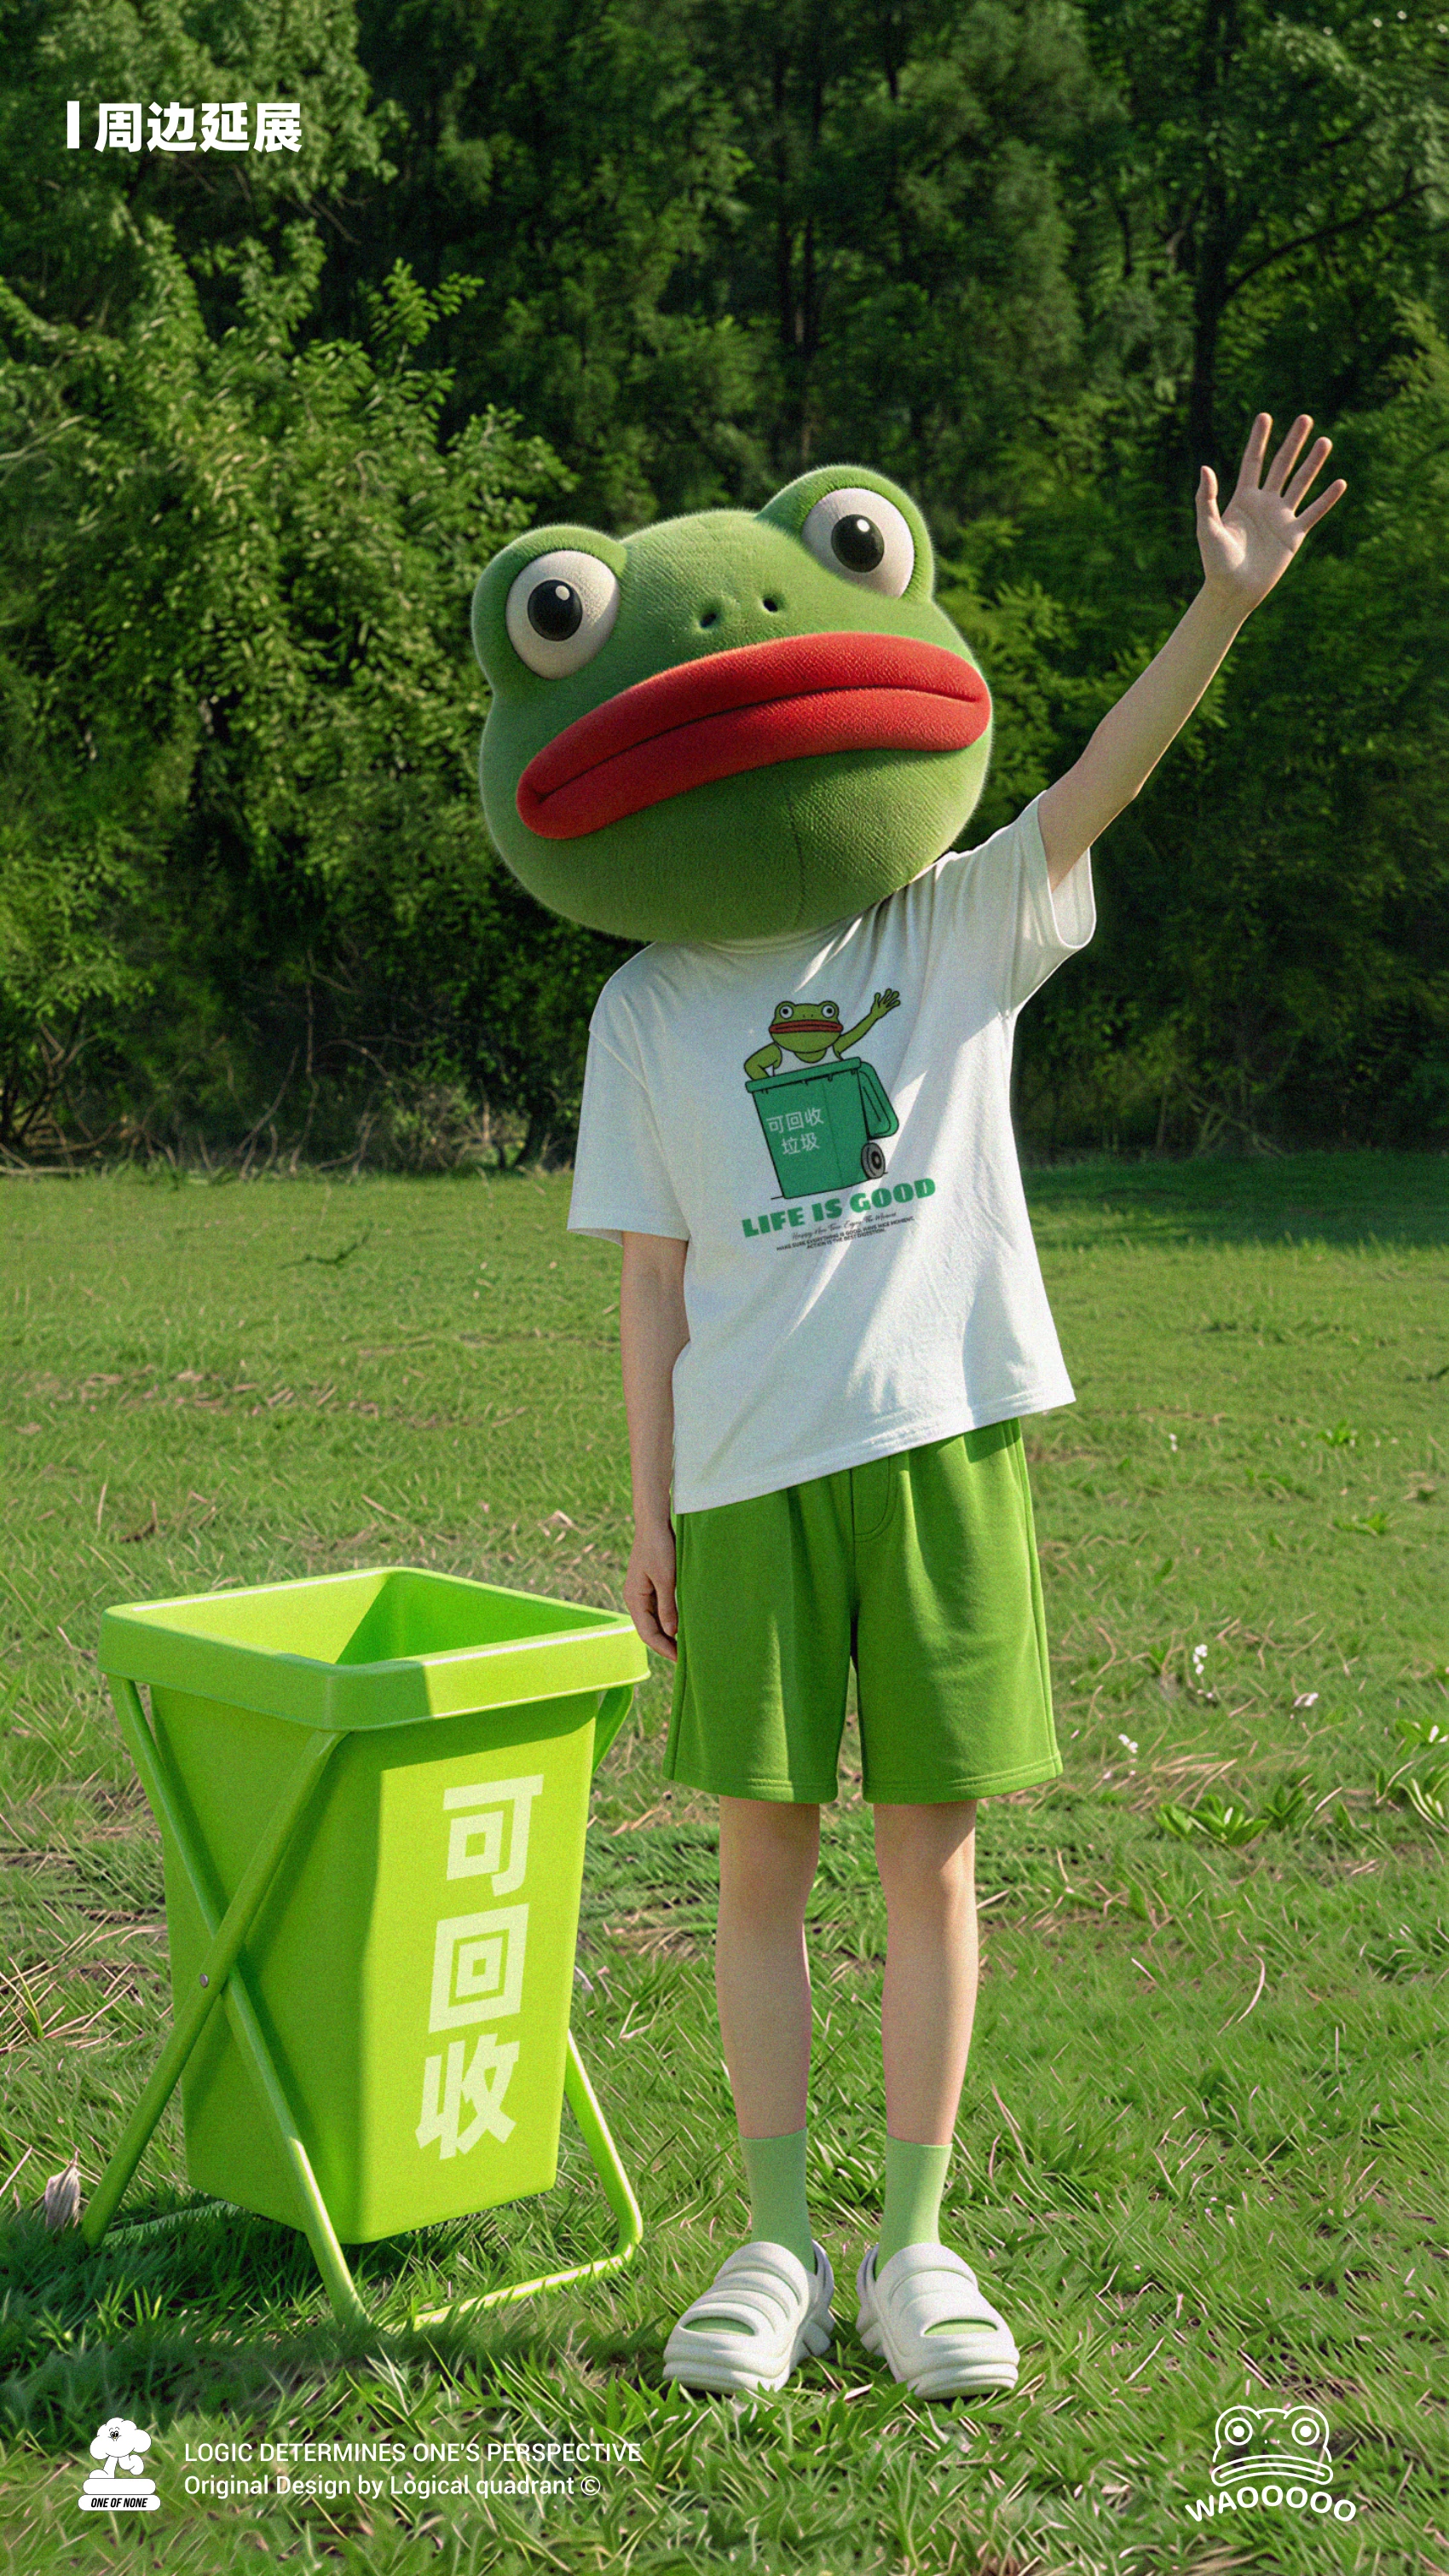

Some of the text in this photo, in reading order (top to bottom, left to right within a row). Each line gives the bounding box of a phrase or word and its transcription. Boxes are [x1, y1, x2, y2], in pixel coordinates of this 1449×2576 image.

[766, 1108, 824, 1133] 可回收
[782, 1132, 820, 1155] 垃圾
[742, 1178, 936, 1237] LIFE IS GOOD
[415, 1774, 544, 2160] 可回收
